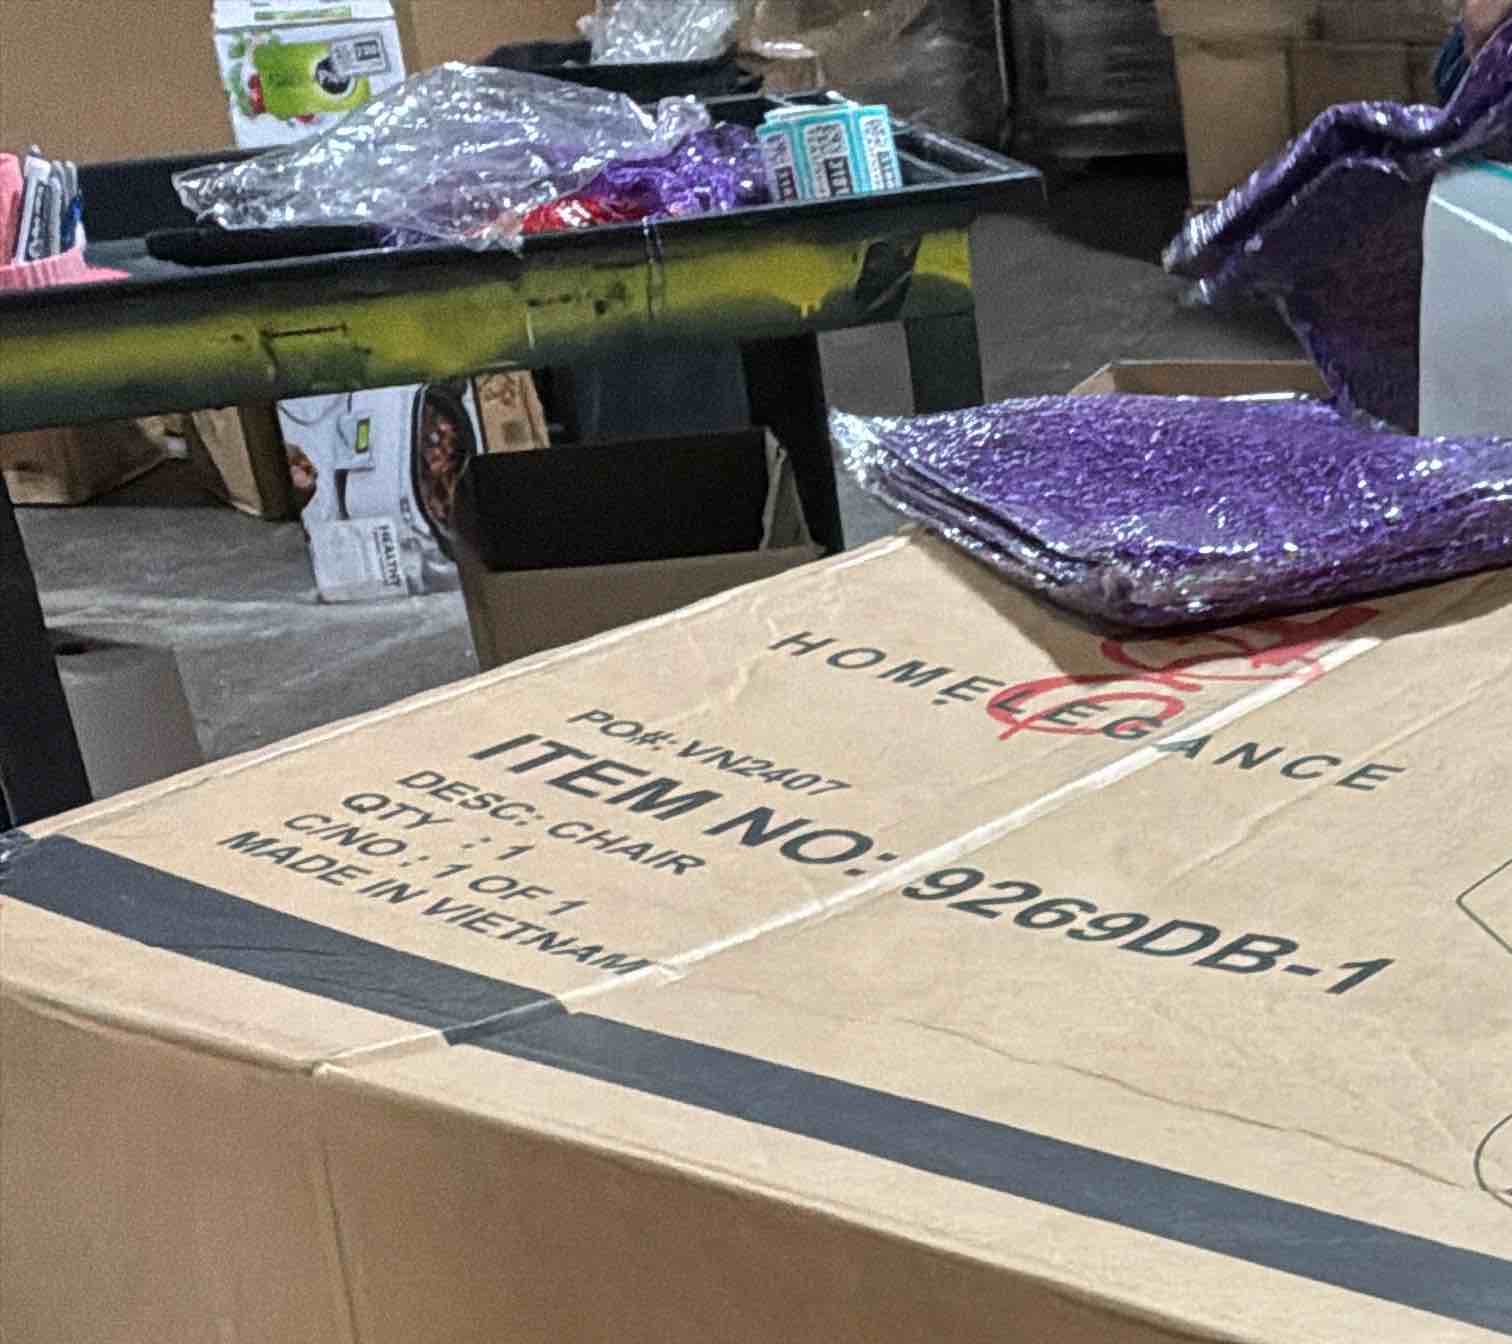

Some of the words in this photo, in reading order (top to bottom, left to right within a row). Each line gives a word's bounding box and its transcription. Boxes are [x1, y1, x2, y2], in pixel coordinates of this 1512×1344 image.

[768, 631, 1405, 791] HOMELEGANCE
[340, 792, 456, 830] QTY
[494, 843, 538, 862] 1
[397, 770, 547, 828] DESC:
[545, 819, 708, 877] CHAIR
[468, 733, 724, 822] ITEM
[702, 806, 899, 877] NO:
[901, 866, 1397, 996] 9269DB-1
[218, 831, 374, 886] MADE
[359, 879, 425, 903] IN
[422, 896, 652, 976] VIETNAM
[432, 864, 468, 880] 1
[468, 875, 558, 901] OF
[553, 899, 591, 919] 1
